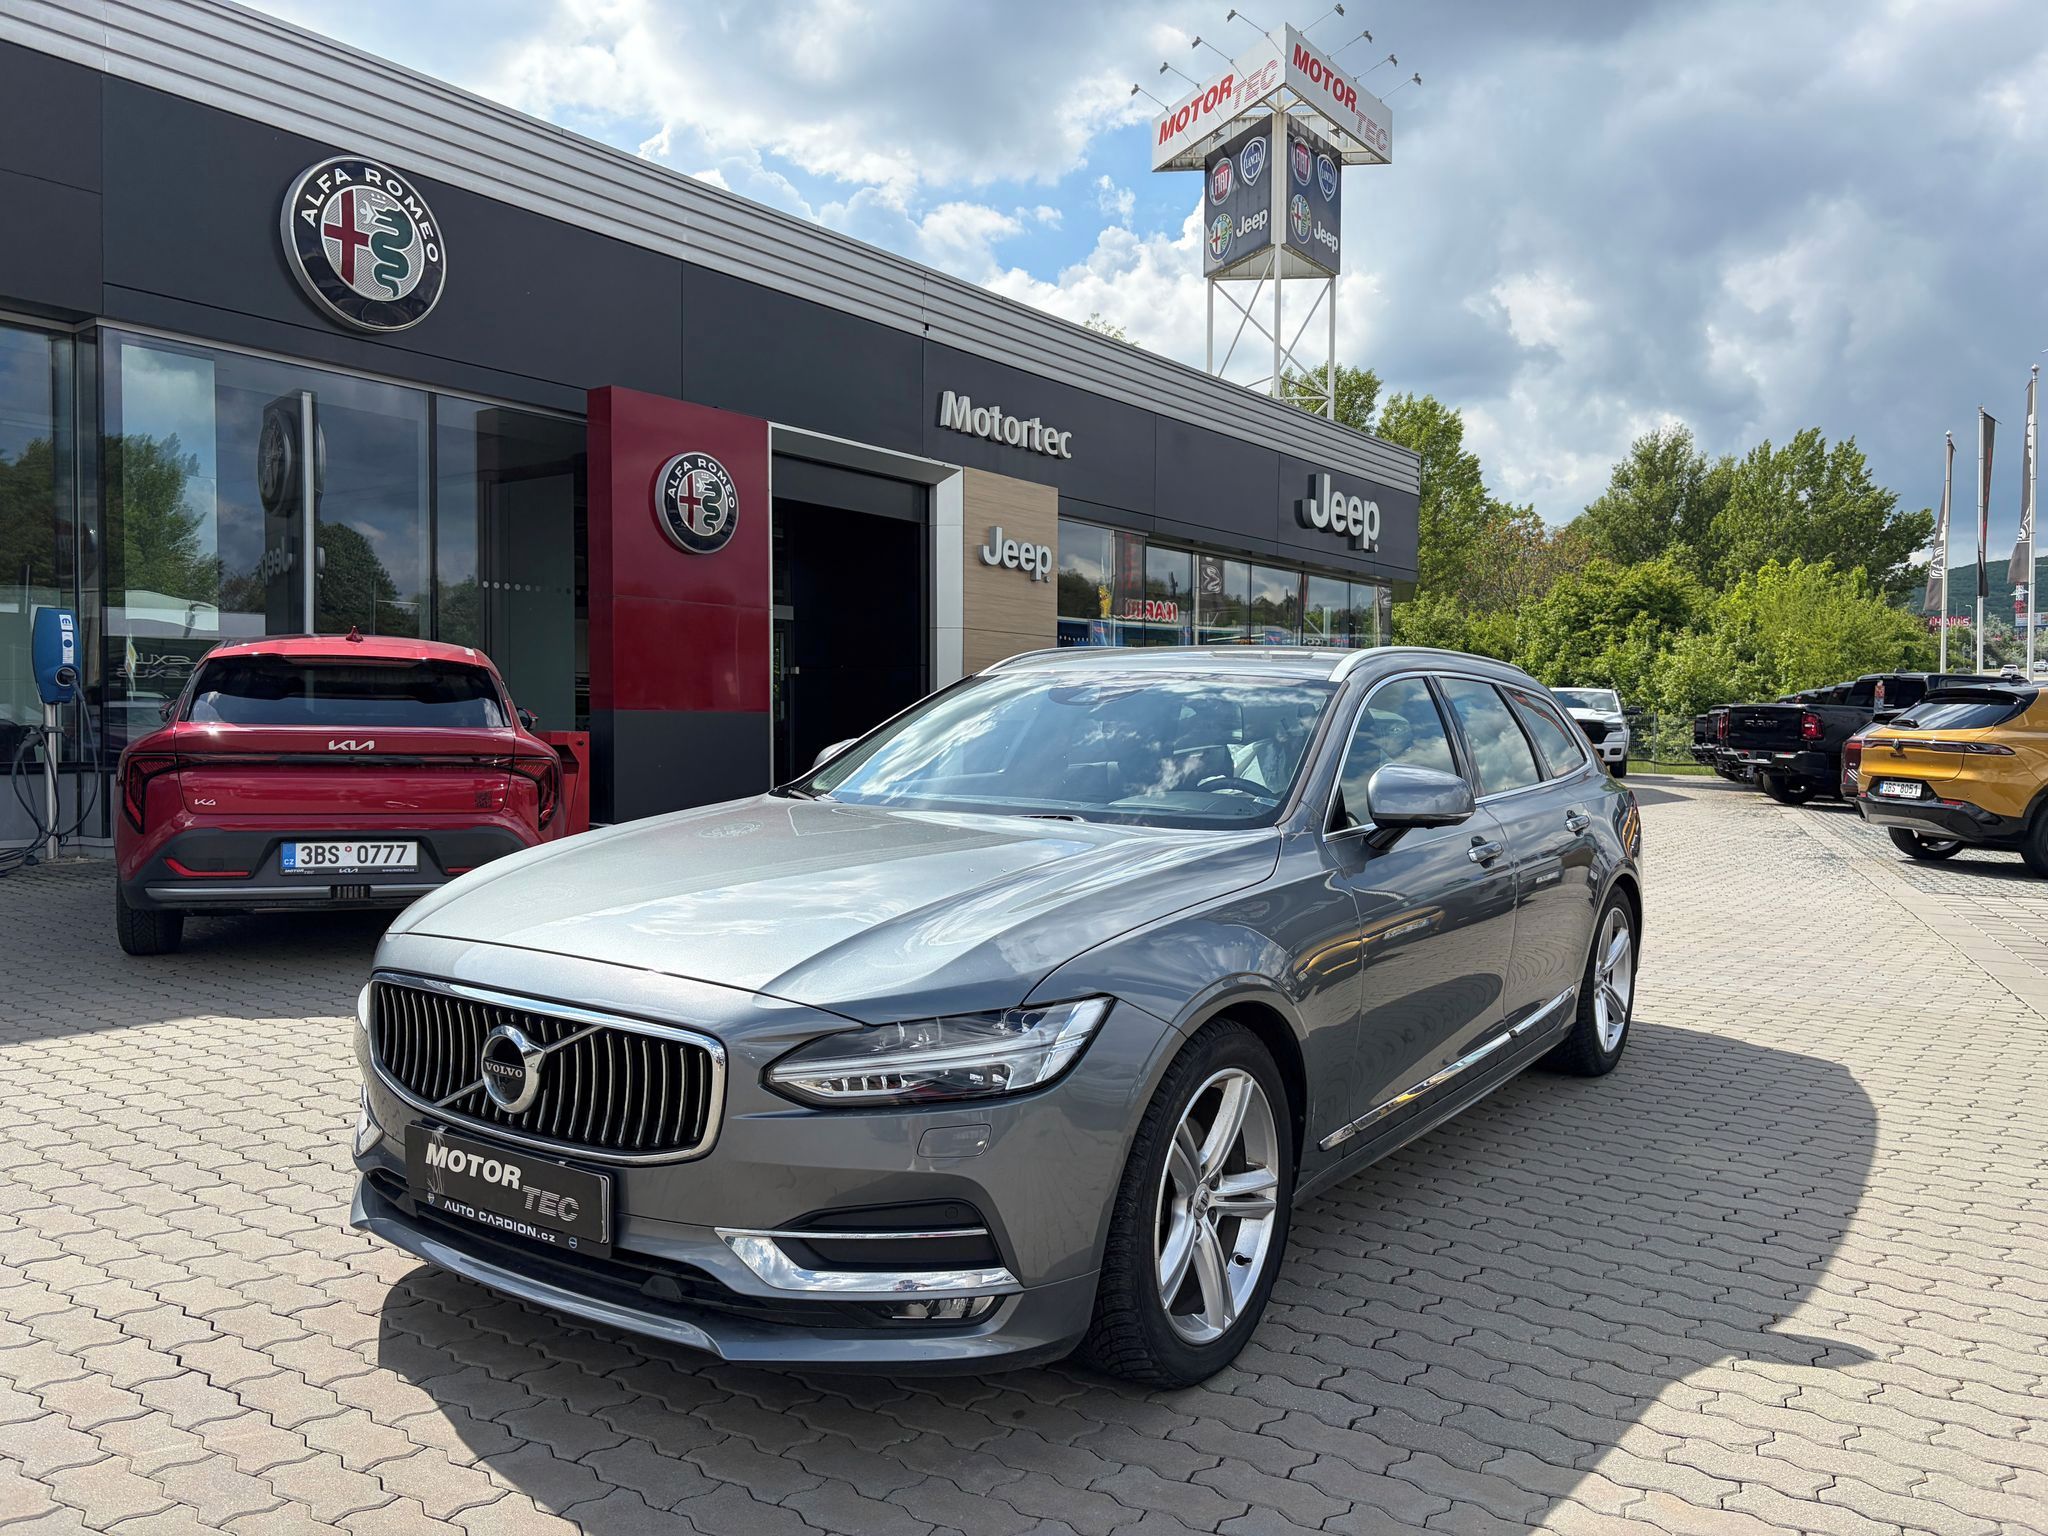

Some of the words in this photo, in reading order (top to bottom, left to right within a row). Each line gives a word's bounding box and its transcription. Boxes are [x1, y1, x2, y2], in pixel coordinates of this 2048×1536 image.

[1158, 74, 1234, 146] MOTOR
[1233, 59, 1278, 110] TEC
[1293, 43, 1357, 112] MOTOR
[1356, 110, 1388, 151] TEC
[1214, 169, 1229, 195] FIAT
[301, 167, 352, 228] ALFA
[364, 167, 439, 263] ROMEO
[1236, 208, 1268, 238] Jeep
[1314, 220, 1339, 253] Jeep
[939, 390, 1073, 460] Motortec
[668, 461, 693, 499] ALFA
[697, 458, 736, 508] ROMEO
[1308, 472, 1380, 550] Jeep
[980, 525, 1053, 581] Jeep
[328, 740, 375, 751] KIA
[1899, 783, 1918, 795] 8051
[284, 858, 295, 866] CZ
[300, 845, 340, 865] 3BS
[356, 844, 408, 864] 0777
[484, 1062, 523, 1078] VOLVO
[425, 1142, 522, 1190] MOTOR
[521, 1184, 580, 1222] TEC
[443, 1199, 475, 1218] AUTO
[478, 1210, 556, 1243] CARDION.cz
